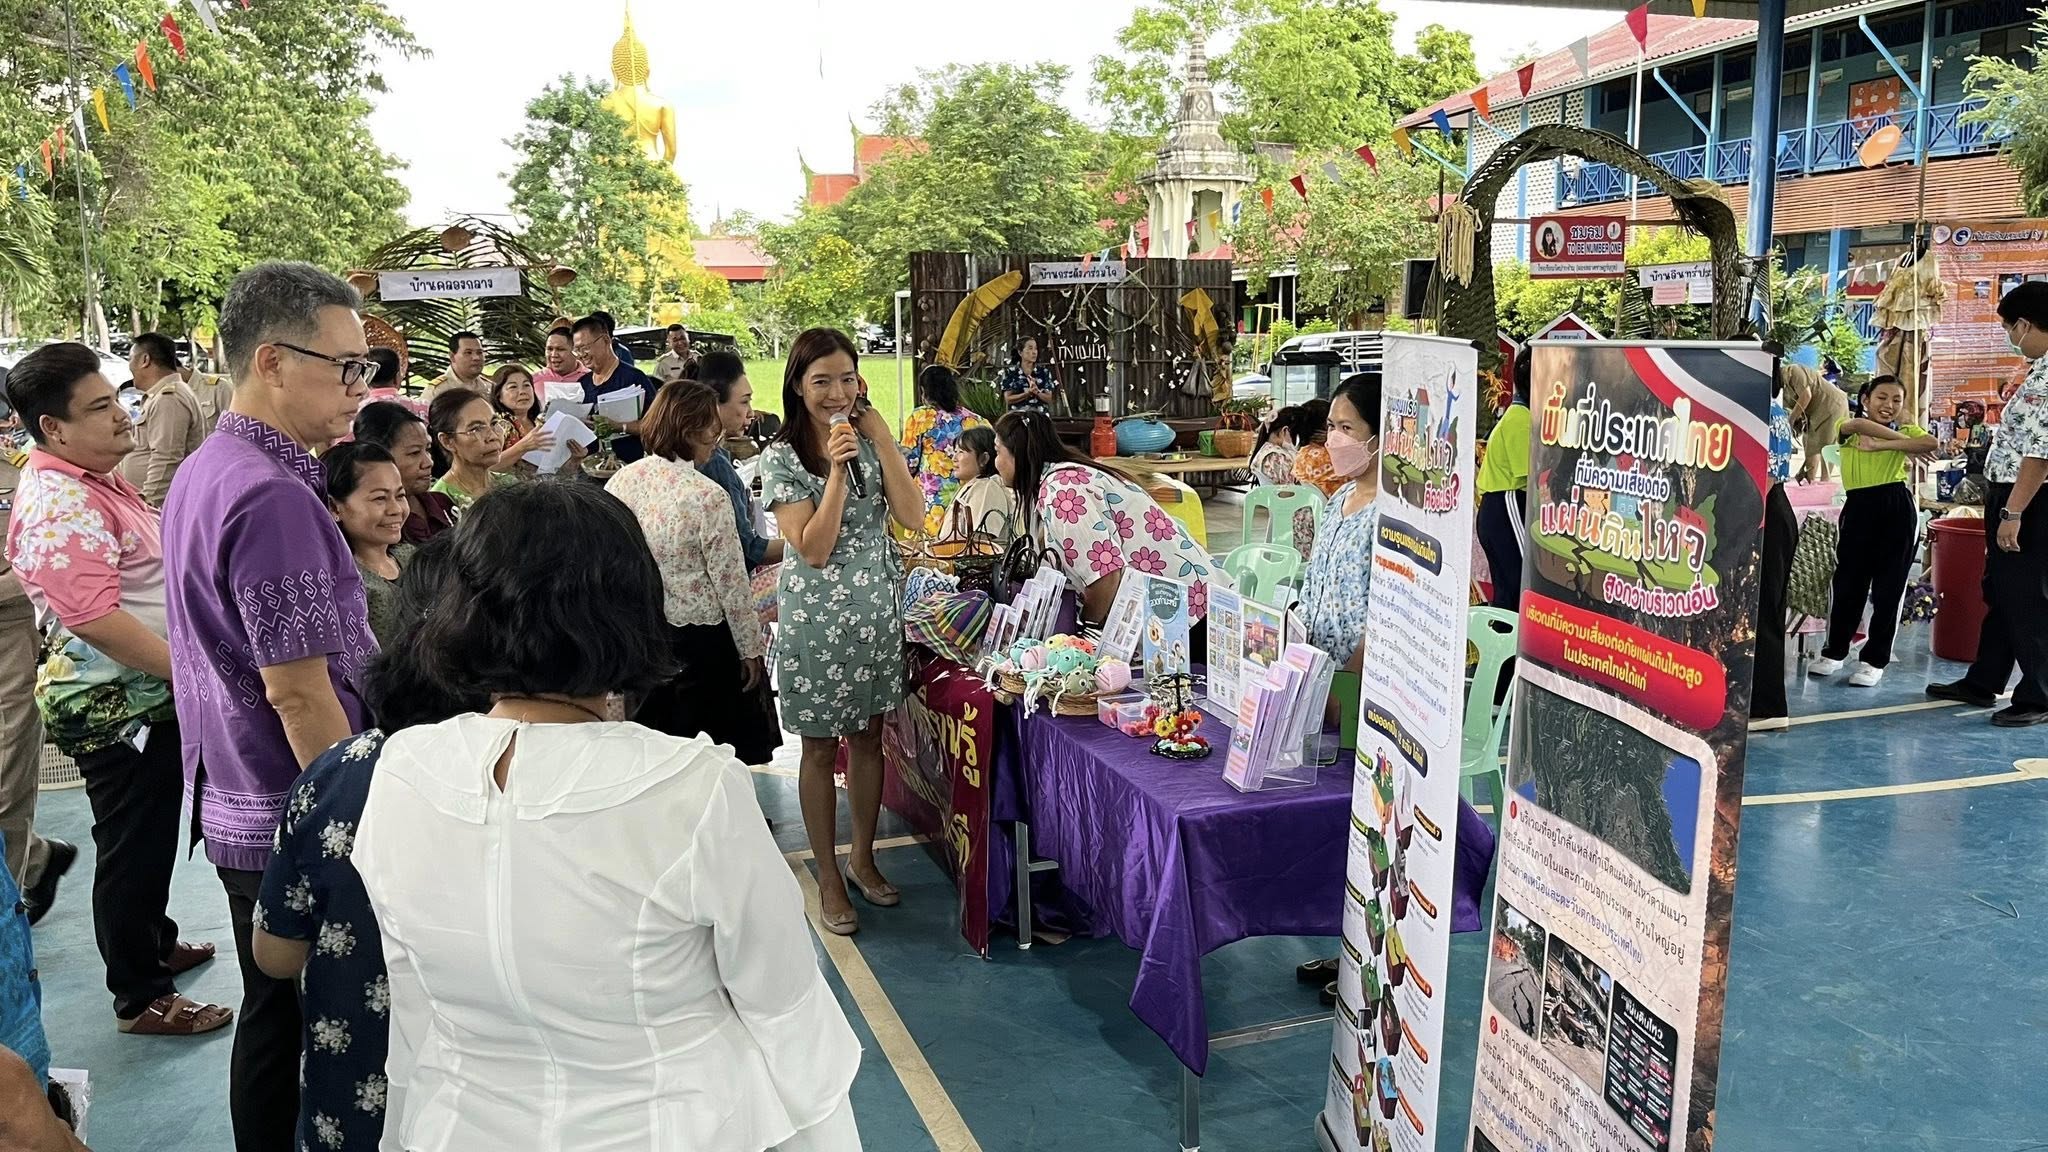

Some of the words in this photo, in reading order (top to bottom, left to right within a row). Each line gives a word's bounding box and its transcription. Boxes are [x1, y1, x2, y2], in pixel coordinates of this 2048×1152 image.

[1567, 243, 1575, 255] TO
[1576, 243, 1585, 255] BE
[1586, 242, 1609, 255] NUMBER
[1610, 242, 1622, 254] ONE
[1571, 226, 1604, 240] ชมรม
[409, 276, 494, 293] บ้านคลองกลาง
[1540, 381, 1733, 471] พื้นที่ประเทศไทย
[1574, 457, 1670, 502] ที่มีความเสี่ยงต่อ
[1540, 486, 1706, 571] แผ่นดินไหว
[1603, 573, 1718, 618] สูงกว่าบริเวณอื่น
[1562, 640, 1648, 692] ในประเทศไทยได้แก่
